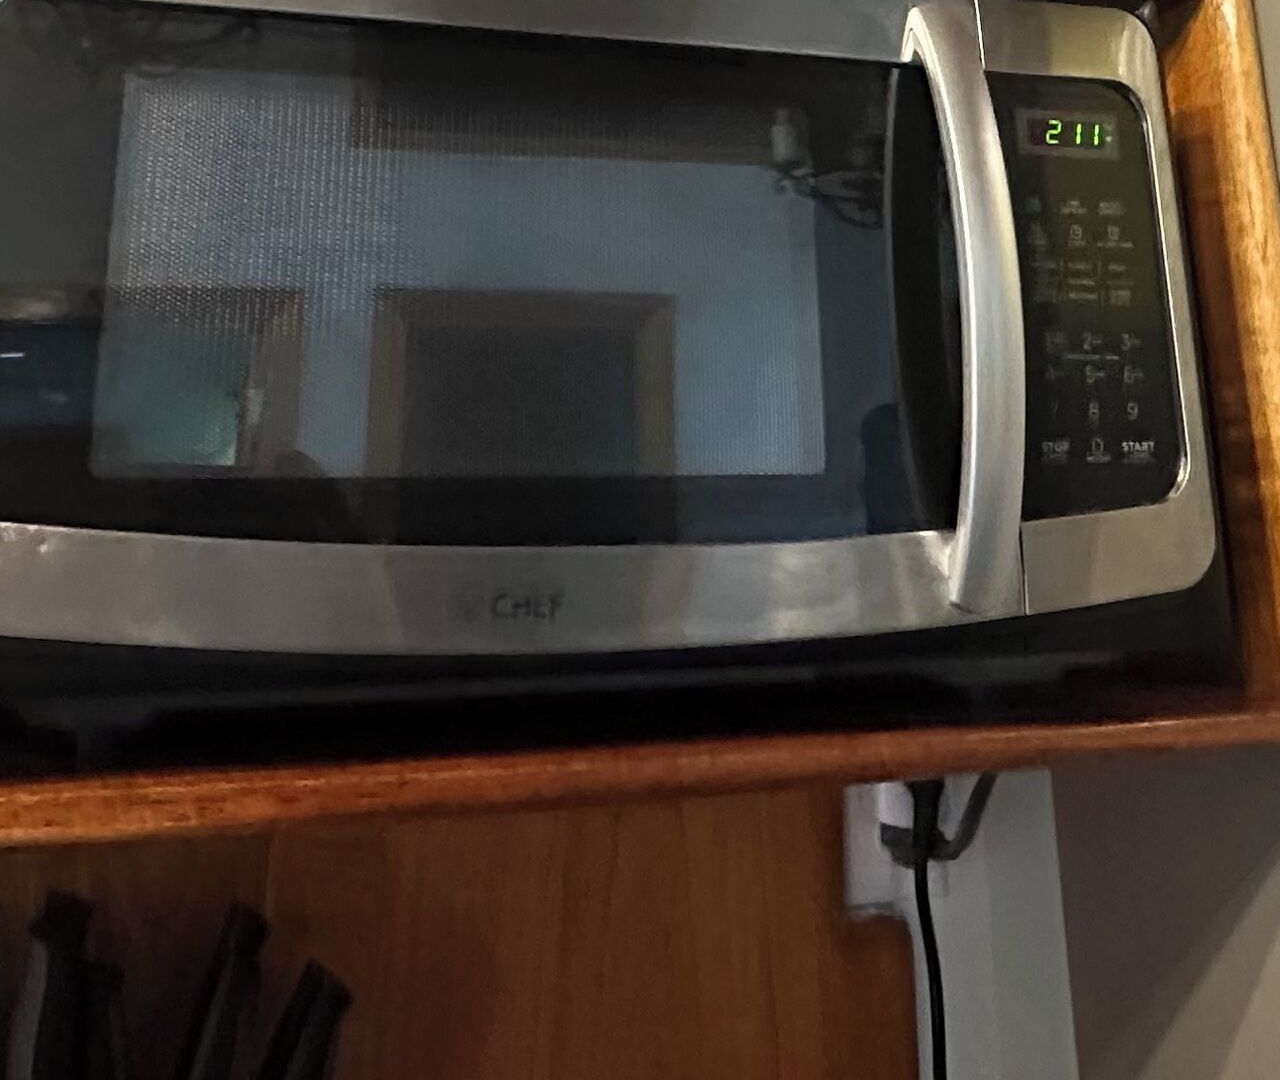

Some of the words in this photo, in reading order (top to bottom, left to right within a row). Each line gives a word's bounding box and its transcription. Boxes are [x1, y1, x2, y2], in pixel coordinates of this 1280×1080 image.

[1127, 402, 1138, 420] 9
[1042, 441, 1070, 453] STOP
[1122, 441, 1155, 452] START
